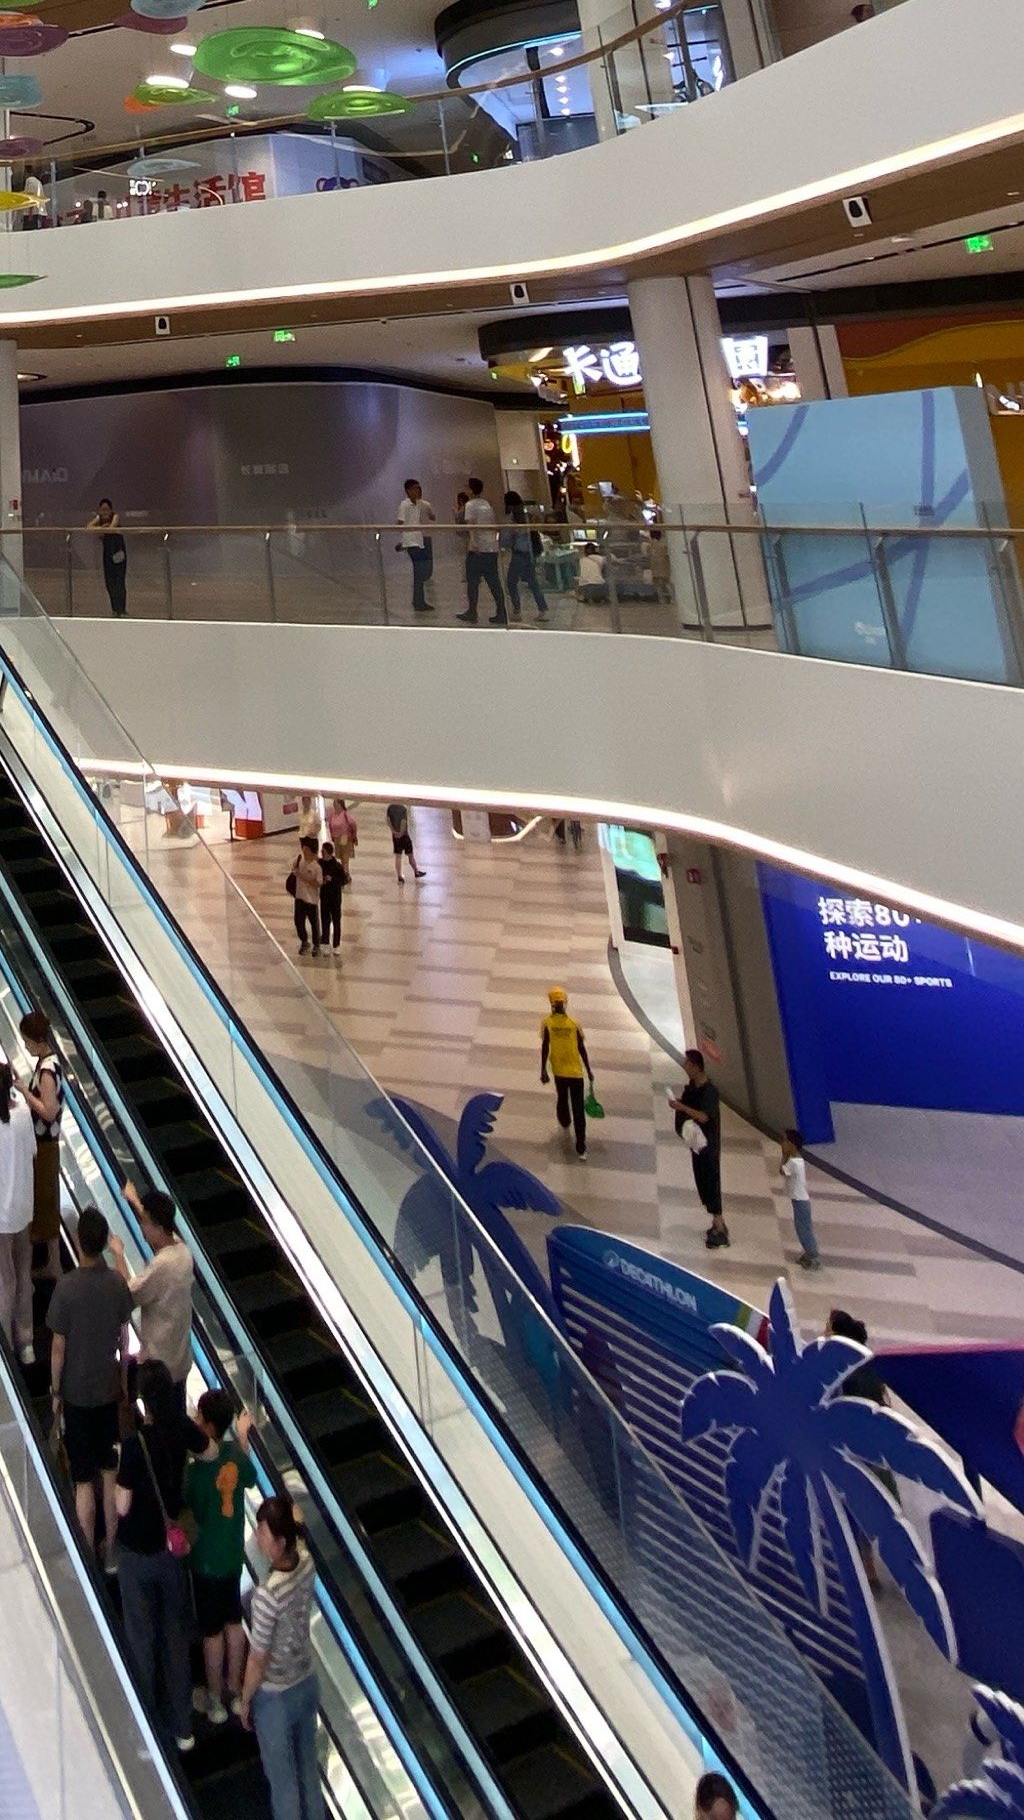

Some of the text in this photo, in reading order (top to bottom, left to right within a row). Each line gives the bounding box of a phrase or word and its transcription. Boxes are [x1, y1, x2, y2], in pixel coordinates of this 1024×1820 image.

[824, 930, 910, 963] 种运动
[829, 971, 871, 983] EXPLORE
[872, 974, 893, 985] OUR
[914, 976, 953, 988] SPORTS
[620, 1258, 697, 1312] DECATHLON
